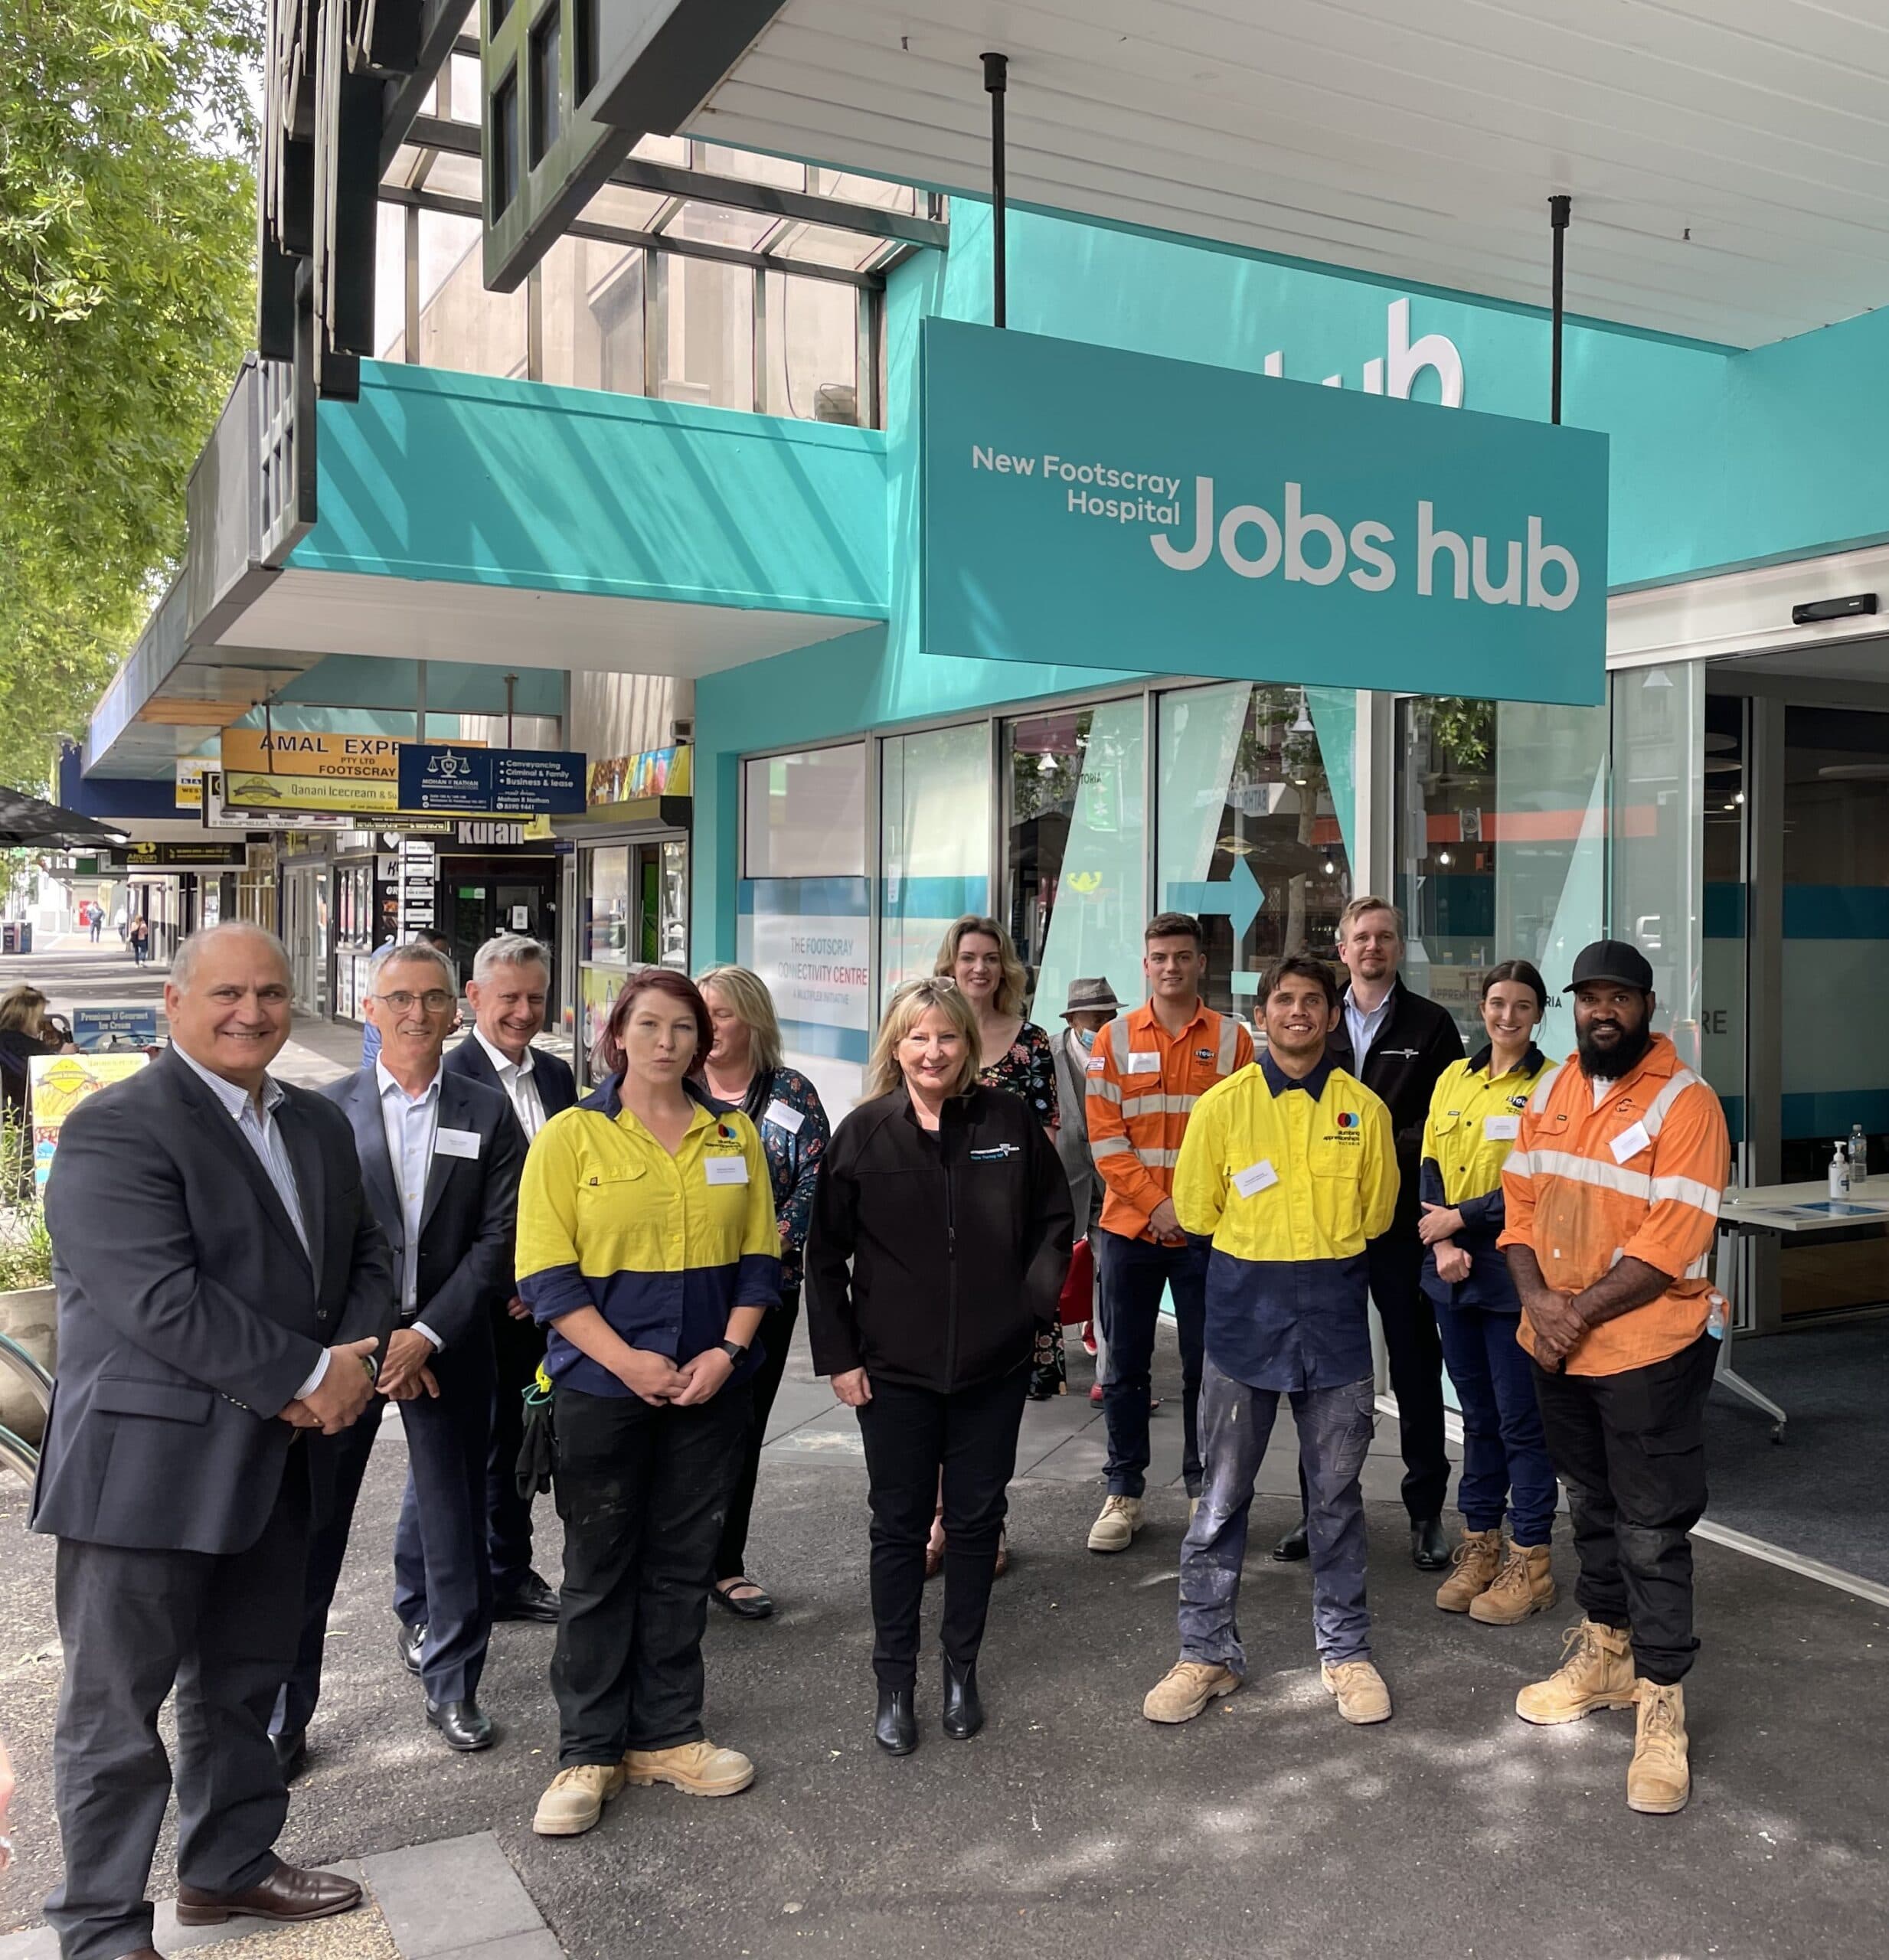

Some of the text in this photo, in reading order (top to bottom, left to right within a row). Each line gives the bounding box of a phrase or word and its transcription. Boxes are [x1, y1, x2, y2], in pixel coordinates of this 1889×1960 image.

[972, 445, 1181, 498] New Footscray
[1067, 490, 1181, 527] Hospital
[1149, 475, 1580, 612] Jobs hub
[260, 735, 399, 756] AMAL EXPR
[319, 766, 396, 776] FOOTSCRAY
[505, 760, 561, 769] Conveyancing
[546, 770, 570, 779] Family
[505, 778, 541, 786] Business
[551, 779, 574, 788] lease
[292, 784, 326, 796] Qanani
[328, 786, 376, 798] Icecream
[387, 790, 397, 799] Su
[791, 937, 854, 956] THE FOOTSCRAY
[778, 962, 868, 986] CONNECTIVITY CENTRE
[81, 1013, 111, 1021] Premium
[120, 1011, 149, 1020] Gourmet
[98, 1021, 131, 1030] Ice Cream
